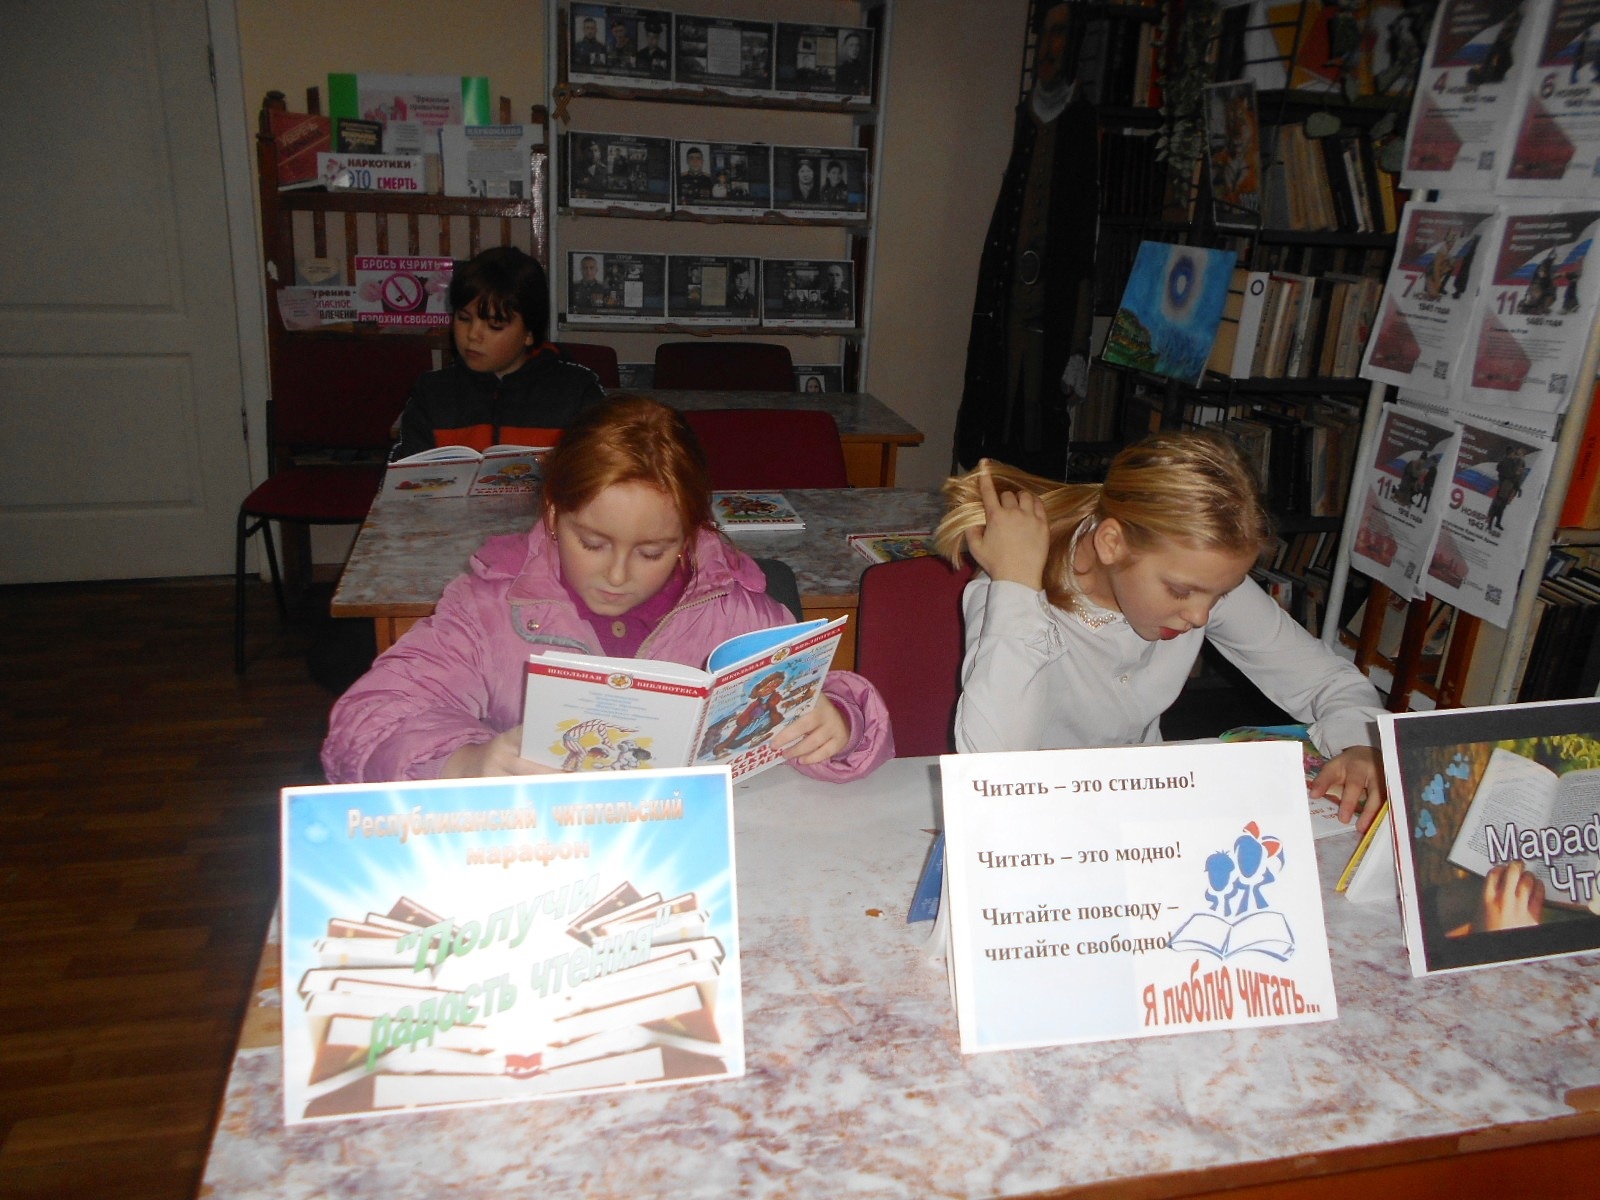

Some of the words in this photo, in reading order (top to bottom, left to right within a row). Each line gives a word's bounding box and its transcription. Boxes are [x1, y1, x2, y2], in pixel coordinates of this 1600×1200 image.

[348, 158, 411, 169] НАРКОТИКИ
[349, 169, 371, 190] ЭТО
[377, 177, 418, 190] СМЕРТЬ
[362, 258, 397, 270] БРОСЬ
[399, 258, 443, 270] КУРИТЬ
[312, 289, 351, 299] урение
[1402, 274, 1419, 298] 7
[1496, 291, 1519, 315] 11
[403, 314, 450, 325] СВОБОДНО
[1377, 476, 1392, 499] 11
[1449, 487, 1465, 510] 9
[547, 667, 602, 682] ШКОЛЬНАЯ
[636, 680, 699, 696] БИБЛИОТЕКА
[972, 779, 1049, 798] Читать
[1071, 779, 1103, 793] это
[1108, 771, 1196, 792] стильно!
[348, 803, 537, 844] Республиканский
[552, 788, 684, 827] читательский
[466, 838, 590, 868] марафон
[977, 850, 1055, 869] Читать
[1077, 849, 1109, 864] это
[1116, 841, 1182, 865] модно!
[395, 873, 600, 974] "Получи
[981, 903, 1071, 926] Читайте
[1077, 901, 1162, 921] повсюду
[984, 939, 1070, 962] читайте
[1076, 932, 1173, 955] свободно!
[366, 973, 517, 1072] радость
[530, 905, 673, 999] чтения"
[1142, 983, 1159, 1027] Я
[1163, 959, 1235, 1025] люблю
[1236, 967, 1321, 1018] читать...
